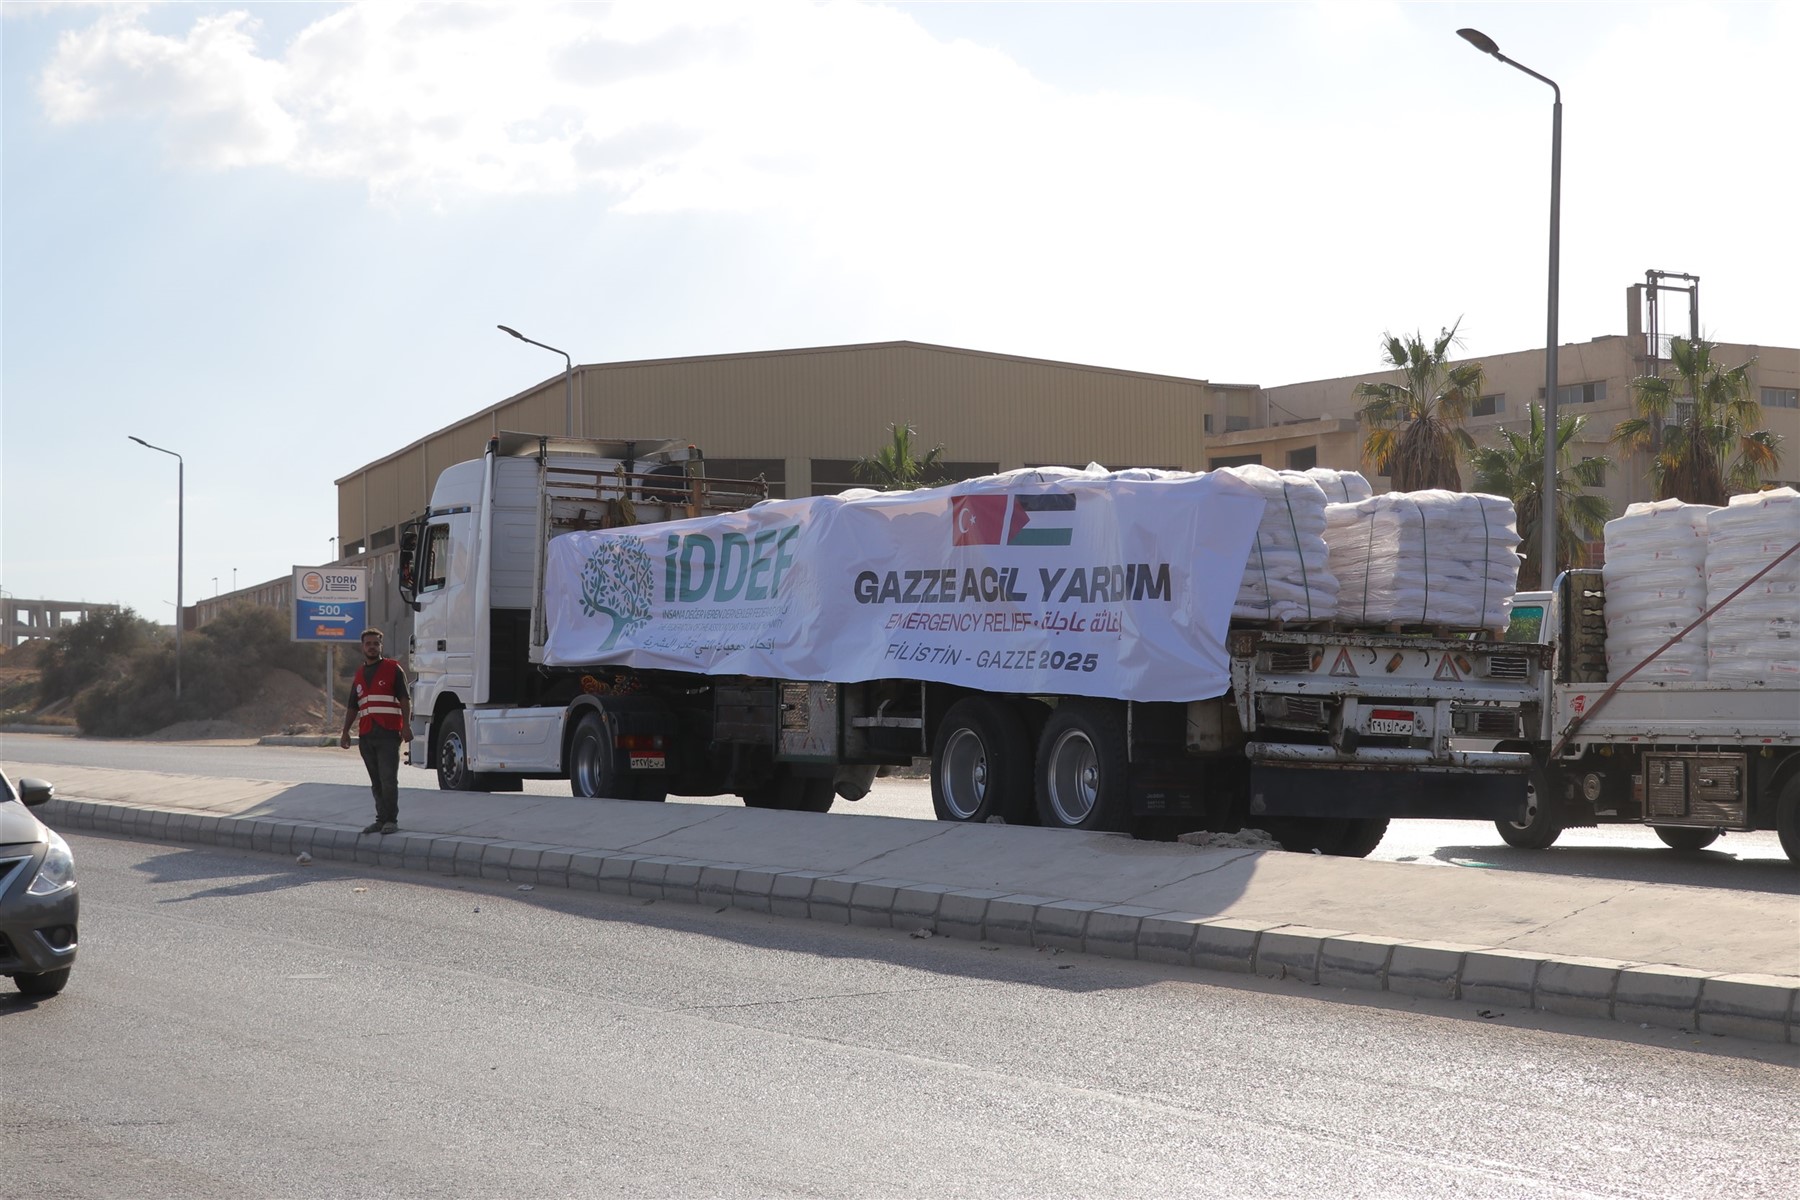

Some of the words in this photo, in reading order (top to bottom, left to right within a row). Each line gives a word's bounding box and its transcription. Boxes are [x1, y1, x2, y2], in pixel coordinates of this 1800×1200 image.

[325, 575, 357, 584] STORM
[854, 569, 956, 604] GAZZE
[959, 566, 1027, 602] ACİL
[1038, 563, 1171, 603] YARDIM
[318, 605, 341, 616] 500
[885, 612, 981, 632] EMERGENCY
[983, 612, 1032, 632] RELIEF
[1041, 610, 1086, 636] عاجلة
[976, 650, 1035, 670] GAZZE
[1038, 651, 1098, 672] 2025
